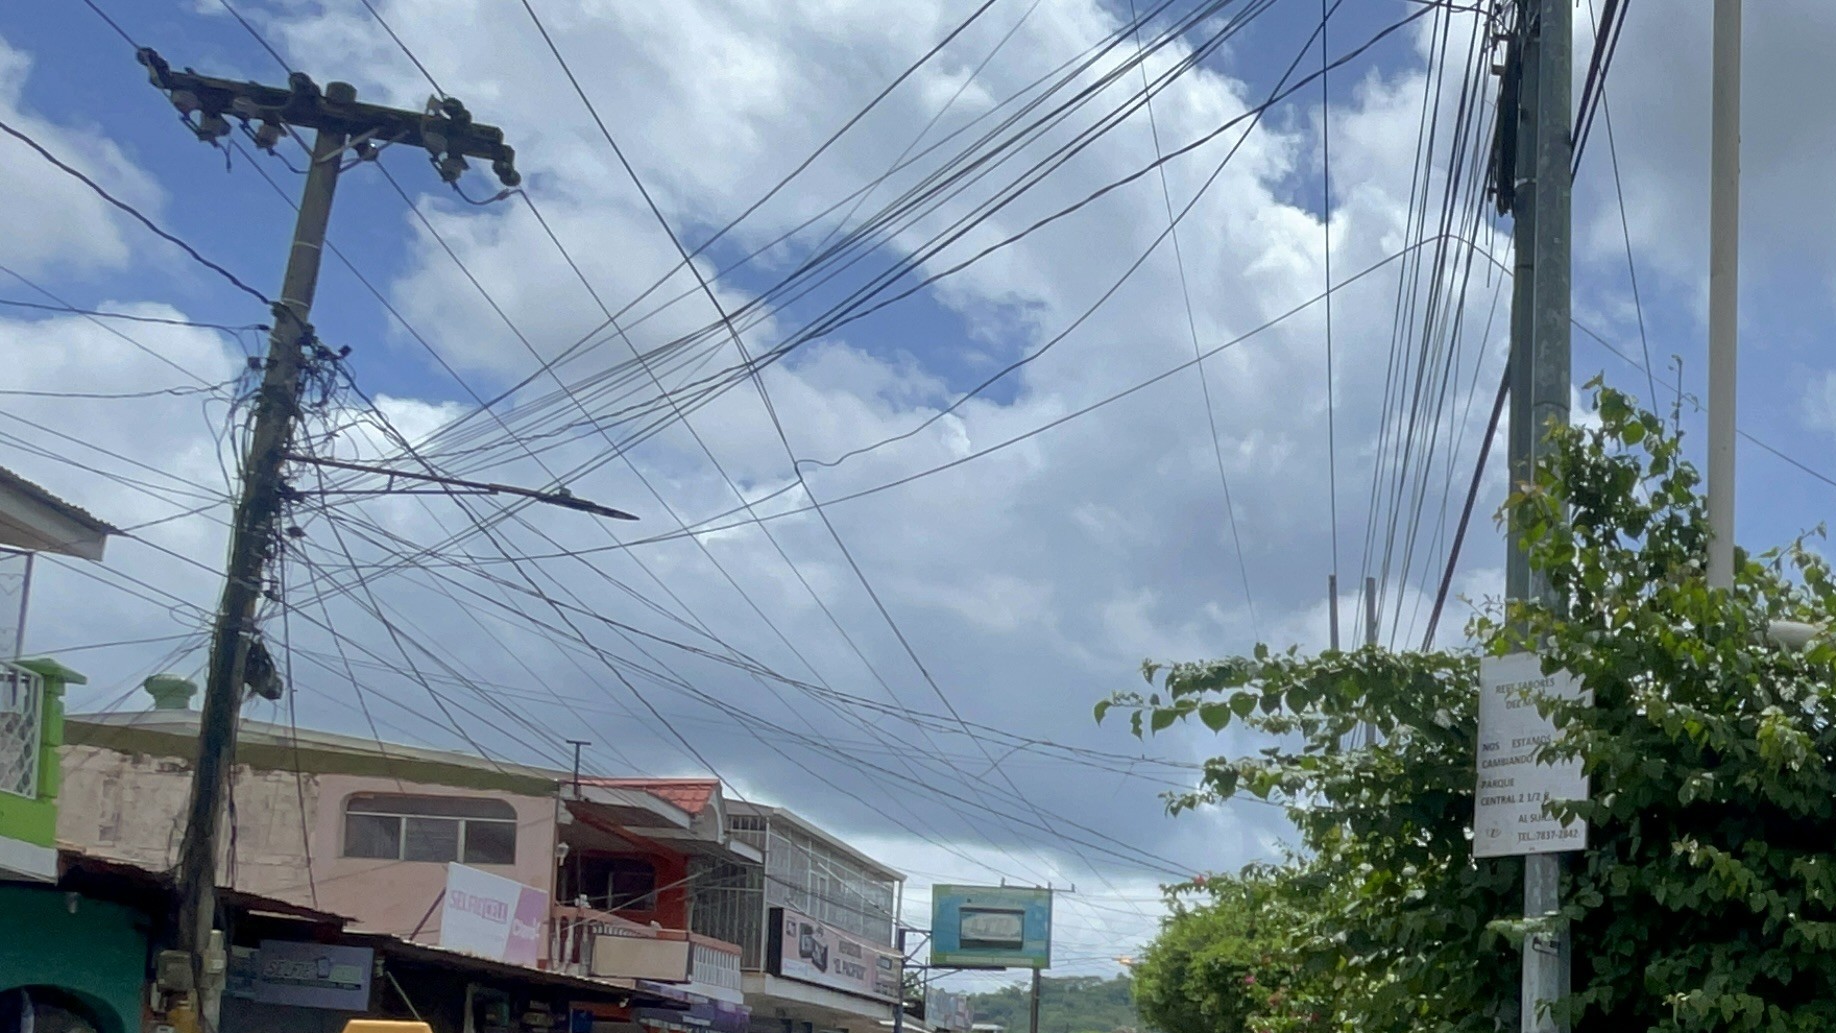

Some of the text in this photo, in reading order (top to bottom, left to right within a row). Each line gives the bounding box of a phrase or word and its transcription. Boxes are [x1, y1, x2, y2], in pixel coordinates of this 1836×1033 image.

[1482, 735, 1551, 751] NOS ESTAMOS
[1482, 755, 1533, 768] CAMBIANDO
[1481, 778, 1514, 788] PARQUE
[1480, 795, 1515, 806] CENTRAL
[1519, 793, 1524, 803] 2
[1528, 792, 1540, 802] 1/2
